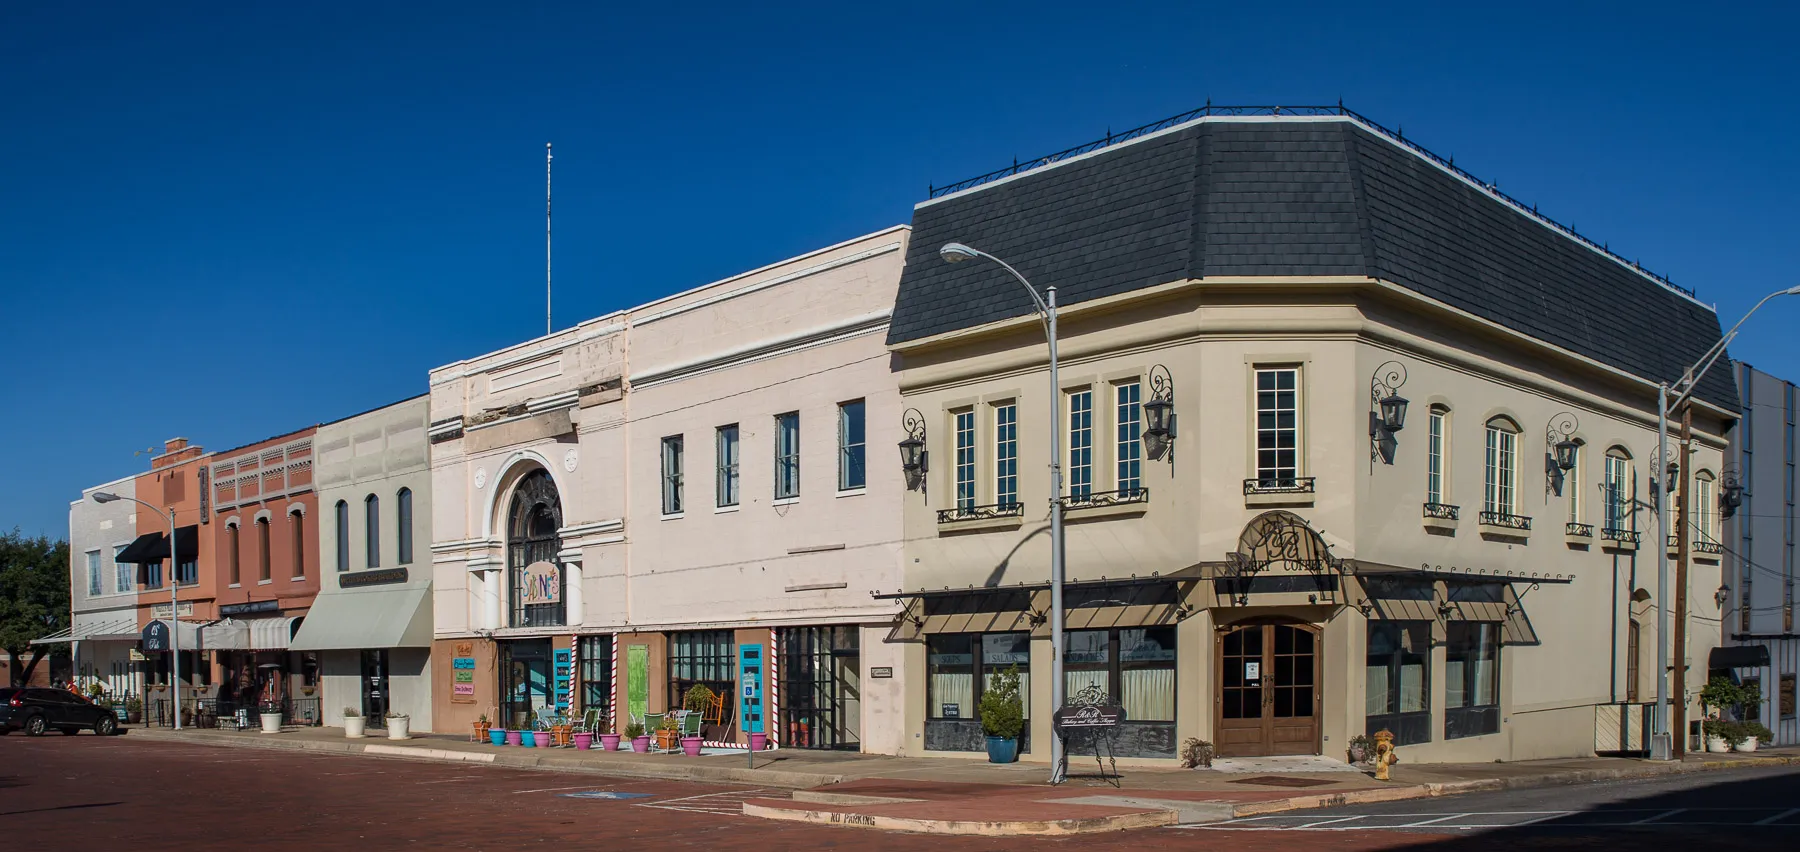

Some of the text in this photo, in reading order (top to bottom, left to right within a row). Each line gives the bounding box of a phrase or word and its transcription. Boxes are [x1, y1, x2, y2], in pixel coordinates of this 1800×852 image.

[1284, 559, 1324, 571] COFFEE
[991, 654, 1018, 663] SALADS
[1077, 710, 1099, 718] R&R
[830, 812, 876, 826] NO PARKING
